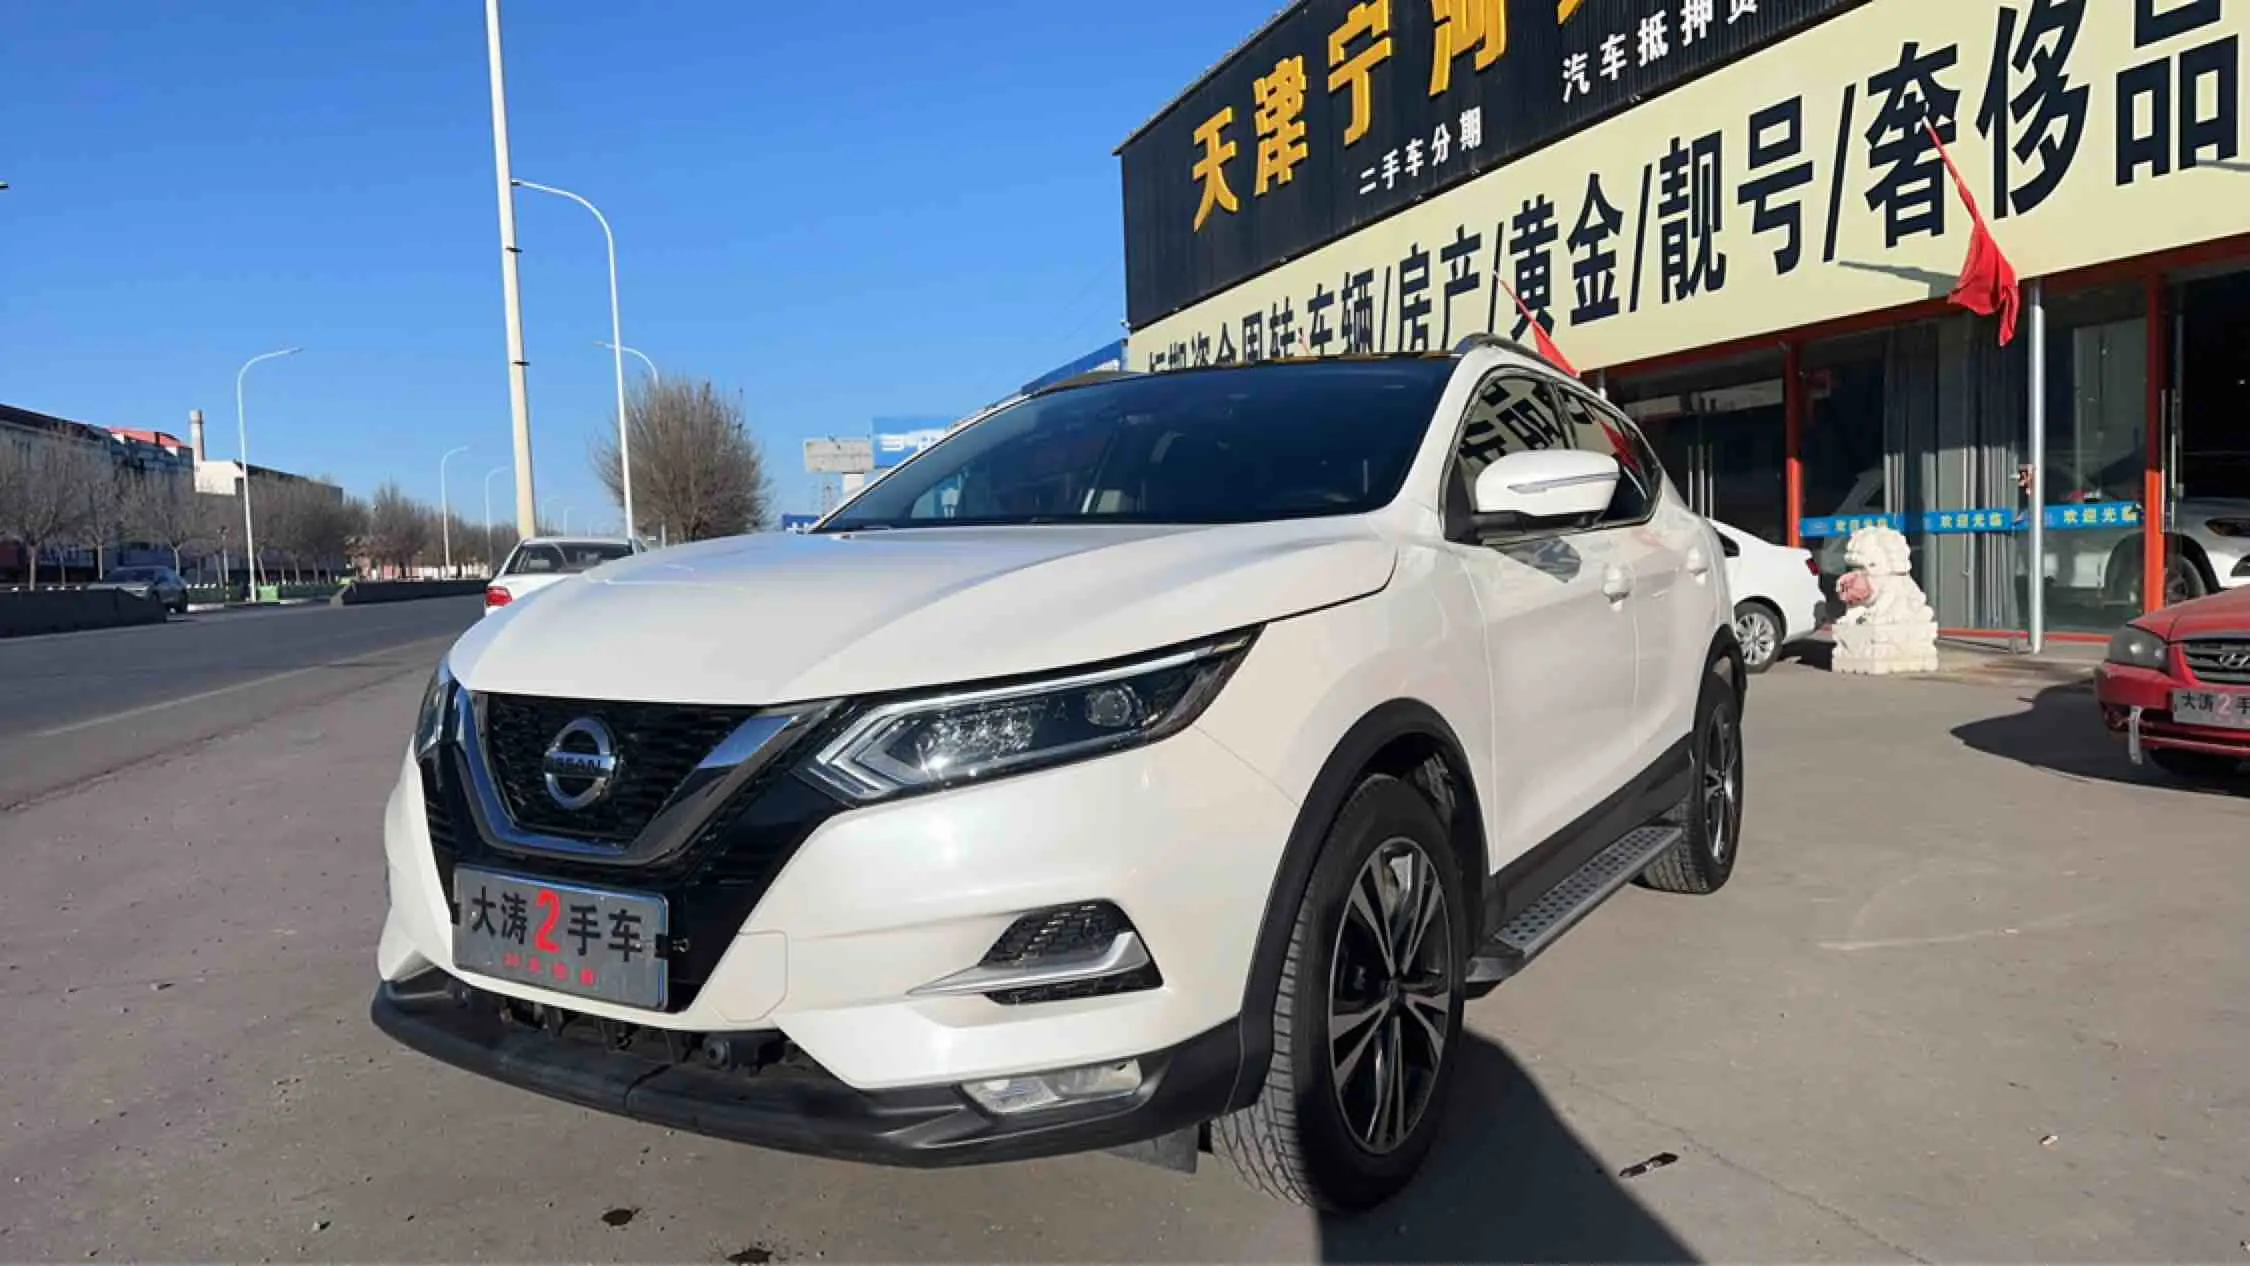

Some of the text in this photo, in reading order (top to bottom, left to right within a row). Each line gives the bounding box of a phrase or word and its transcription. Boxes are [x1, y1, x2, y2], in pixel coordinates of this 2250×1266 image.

[1192, 0, 1584, 232] 天津宁河
[1359, 105, 1482, 195] 二手车分期
[471, 887, 644, 963] 大涛2手车
